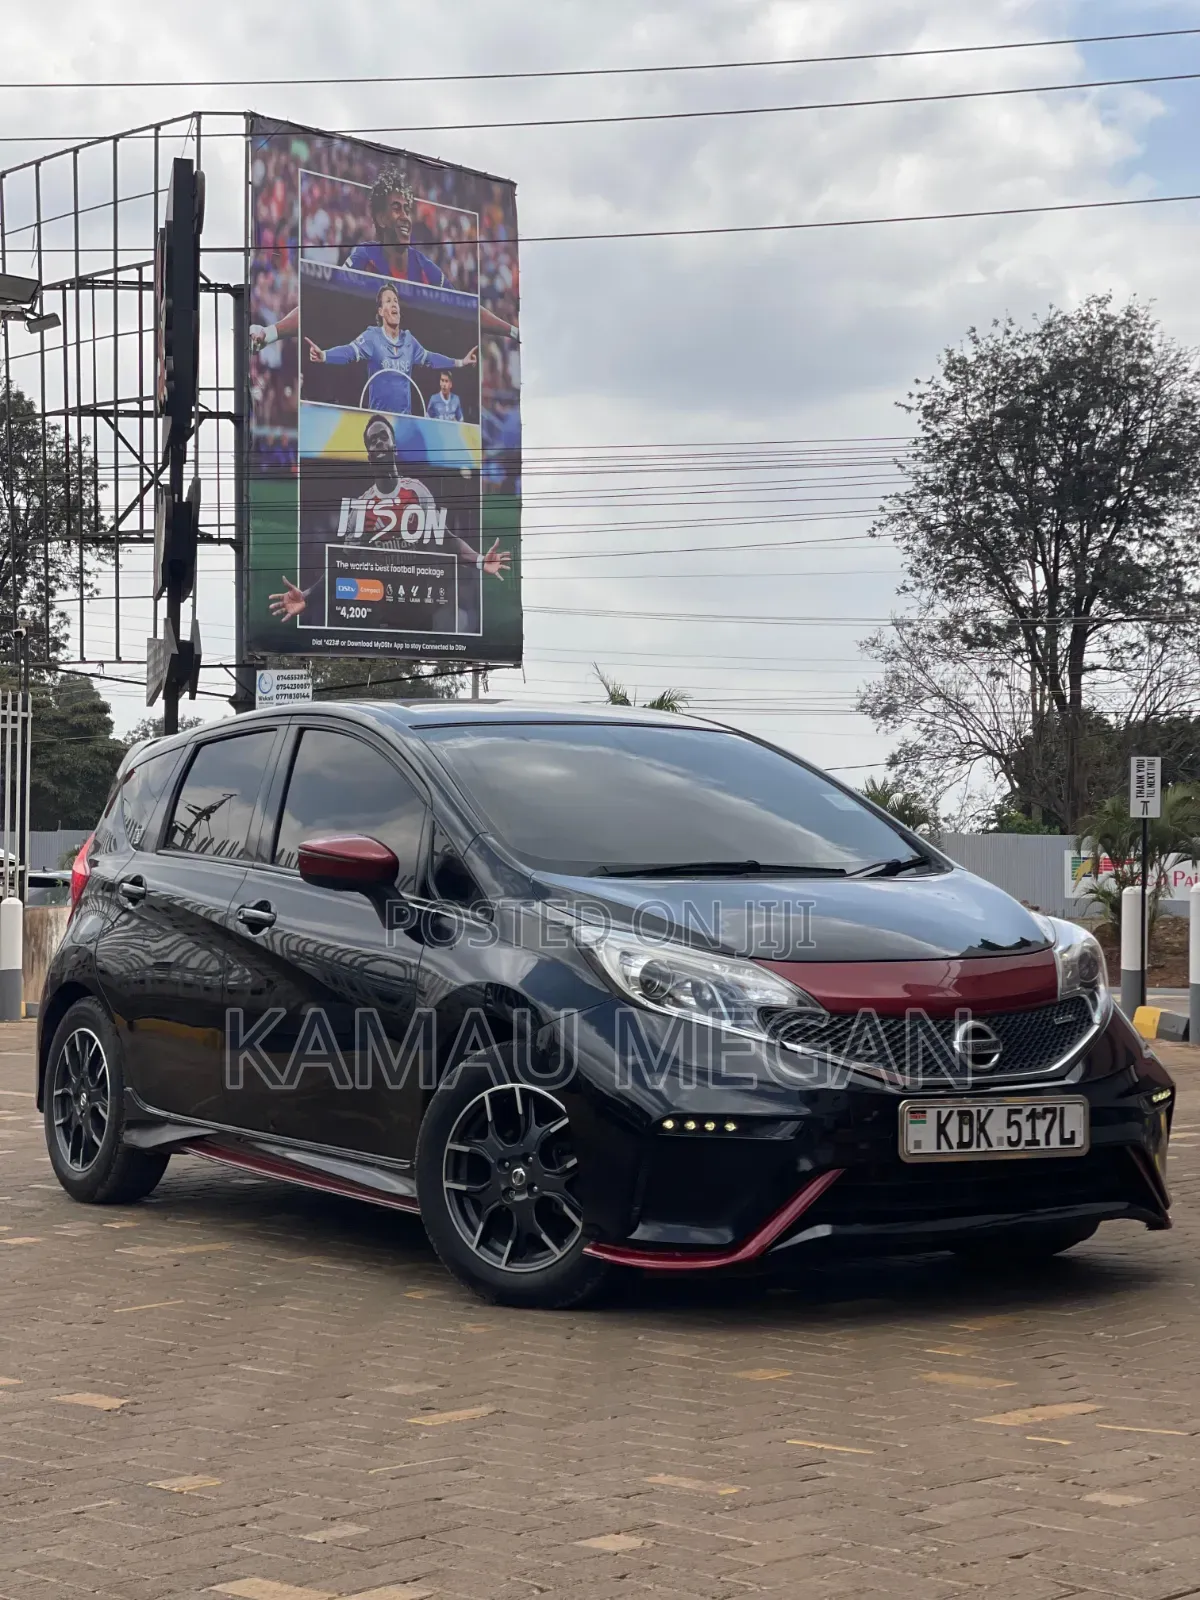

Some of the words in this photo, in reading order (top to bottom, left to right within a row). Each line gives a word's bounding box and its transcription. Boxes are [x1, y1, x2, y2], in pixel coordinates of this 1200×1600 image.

[401, 503, 448, 546] ON
[336, 560, 349, 570] The
[349, 561, 374, 572] world's
[374, 563, 390, 573] best
[390, 563, 416, 575] football
[416, 567, 445, 579] package
[311, 638, 323, 646] Dial
[346, 639, 373, 648] Download
[393, 641, 404, 651] App
[410, 643, 421, 652] stay
[421, 643, 449, 651] Connected
[1135, 759, 1146, 773] YOU
[1146, 758, 1156, 771] TIME
[1135, 774, 1146, 799] THANK
[1146, 772, 1156, 789] NEXT
[1146, 789, 1156, 798] TILL
[936, 1109, 995, 1151] KDK
[1006, 1106, 1077, 1149] 517L
